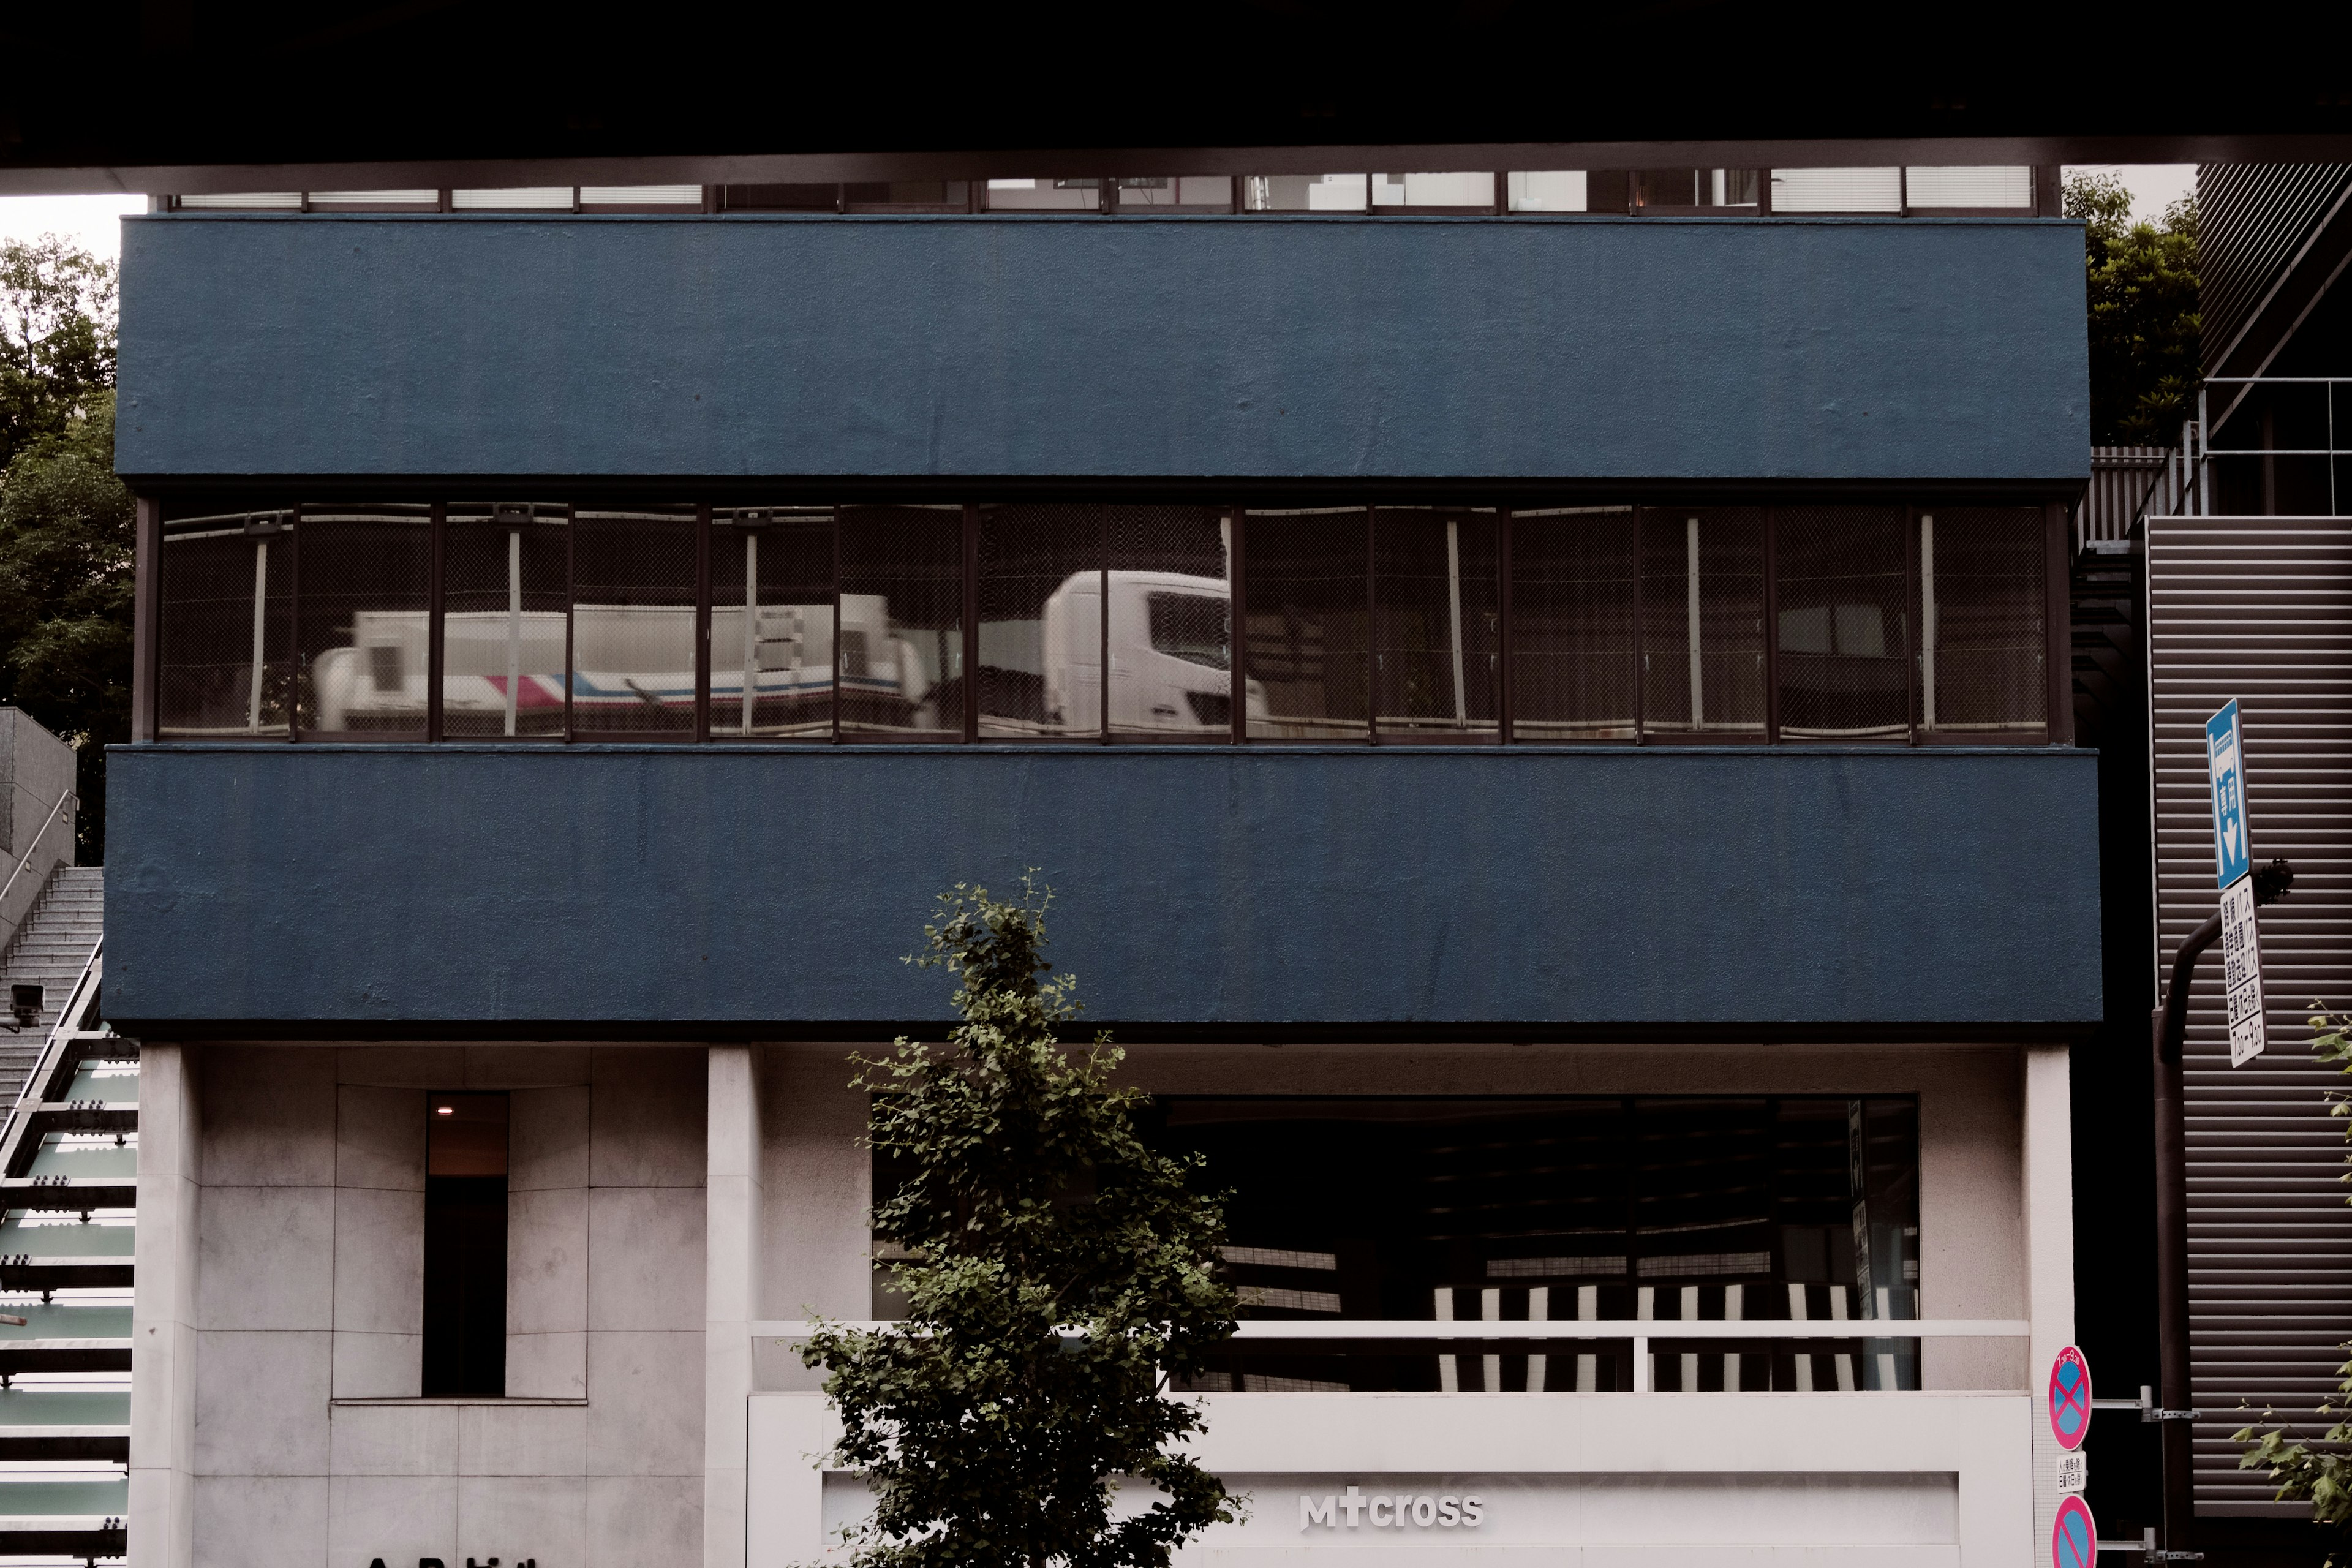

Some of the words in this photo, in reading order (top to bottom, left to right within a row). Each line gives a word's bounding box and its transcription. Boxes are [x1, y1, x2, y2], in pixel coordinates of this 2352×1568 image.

[2219, 776, 2236, 817] 専用
[2223, 887, 2250, 928] 路線バス
